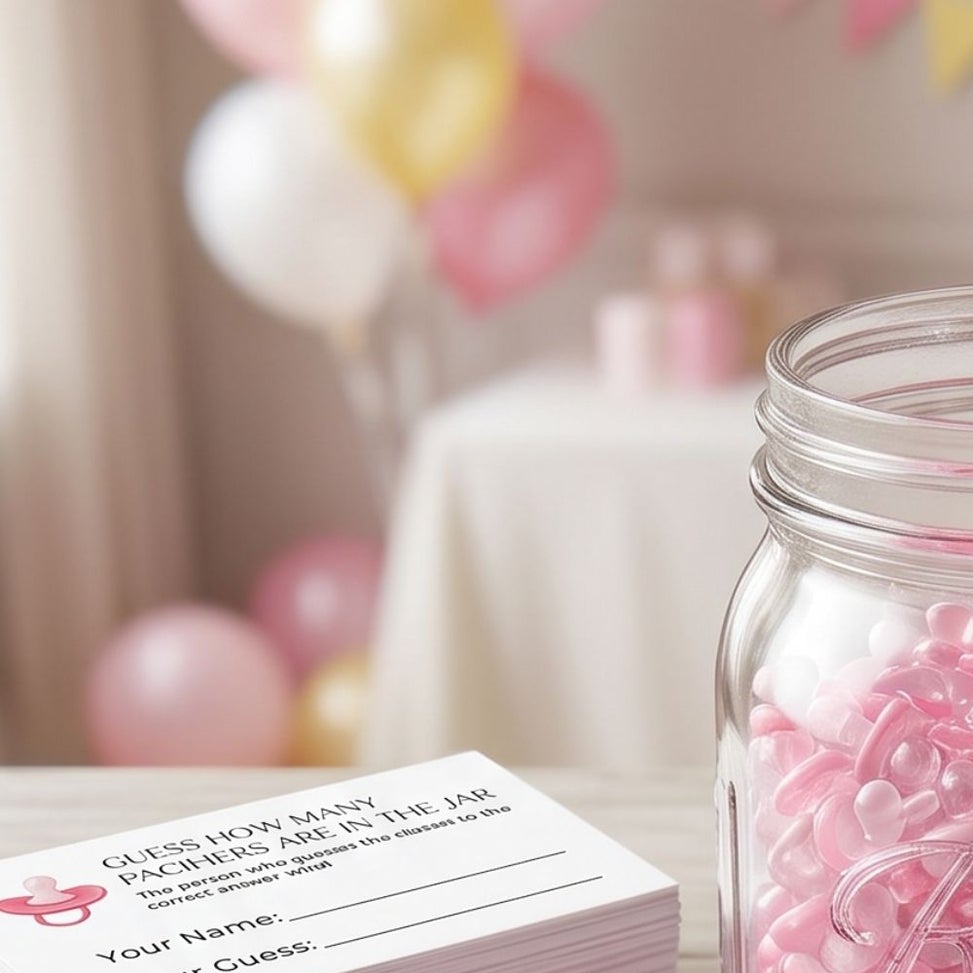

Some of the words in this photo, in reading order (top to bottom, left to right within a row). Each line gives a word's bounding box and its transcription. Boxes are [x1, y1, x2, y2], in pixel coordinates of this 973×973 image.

[103, 839, 200, 869] GUESS
[205, 819, 281, 845] HOW
[289, 797, 375, 825] MANY
[279, 826, 337, 850] ARE
[339, 817, 373, 834] IN
[375, 802, 440, 823] THE
[443, 789, 497, 811] JAR
[245, 860, 287, 873] who
[96, 940, 170, 963] Your
[179, 914, 283, 944] Name:
[214, 941, 317, 972] Guess:
